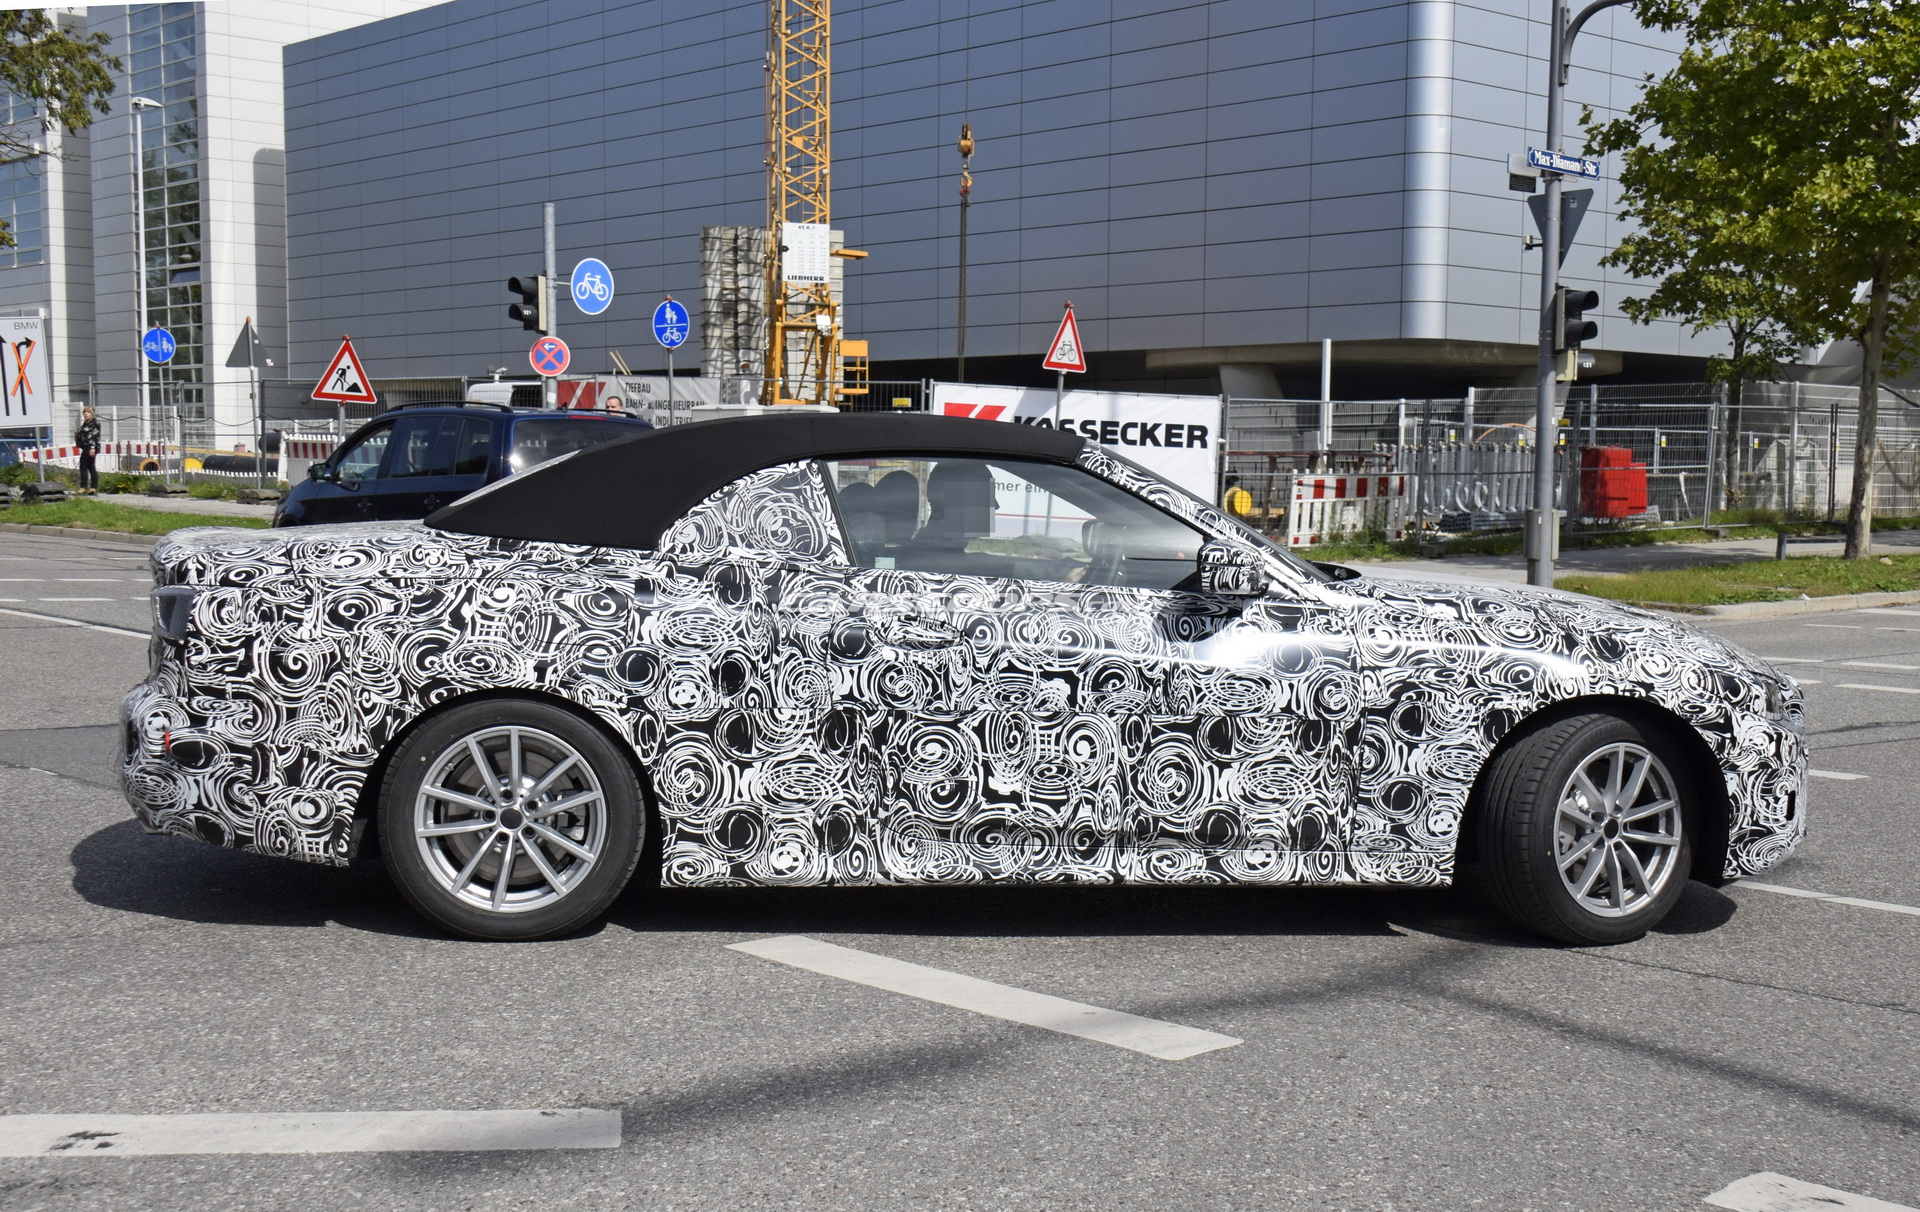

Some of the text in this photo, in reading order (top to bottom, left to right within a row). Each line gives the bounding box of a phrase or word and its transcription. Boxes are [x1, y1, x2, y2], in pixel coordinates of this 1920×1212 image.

[787, 274, 825, 282] LIEBHERR
[13, 321, 39, 330] BMW
[625, 382, 651, 394] TIEFBAU
[625, 398, 647, 410] BAHN-
[655, 400, 705, 412] INGEIEURB
